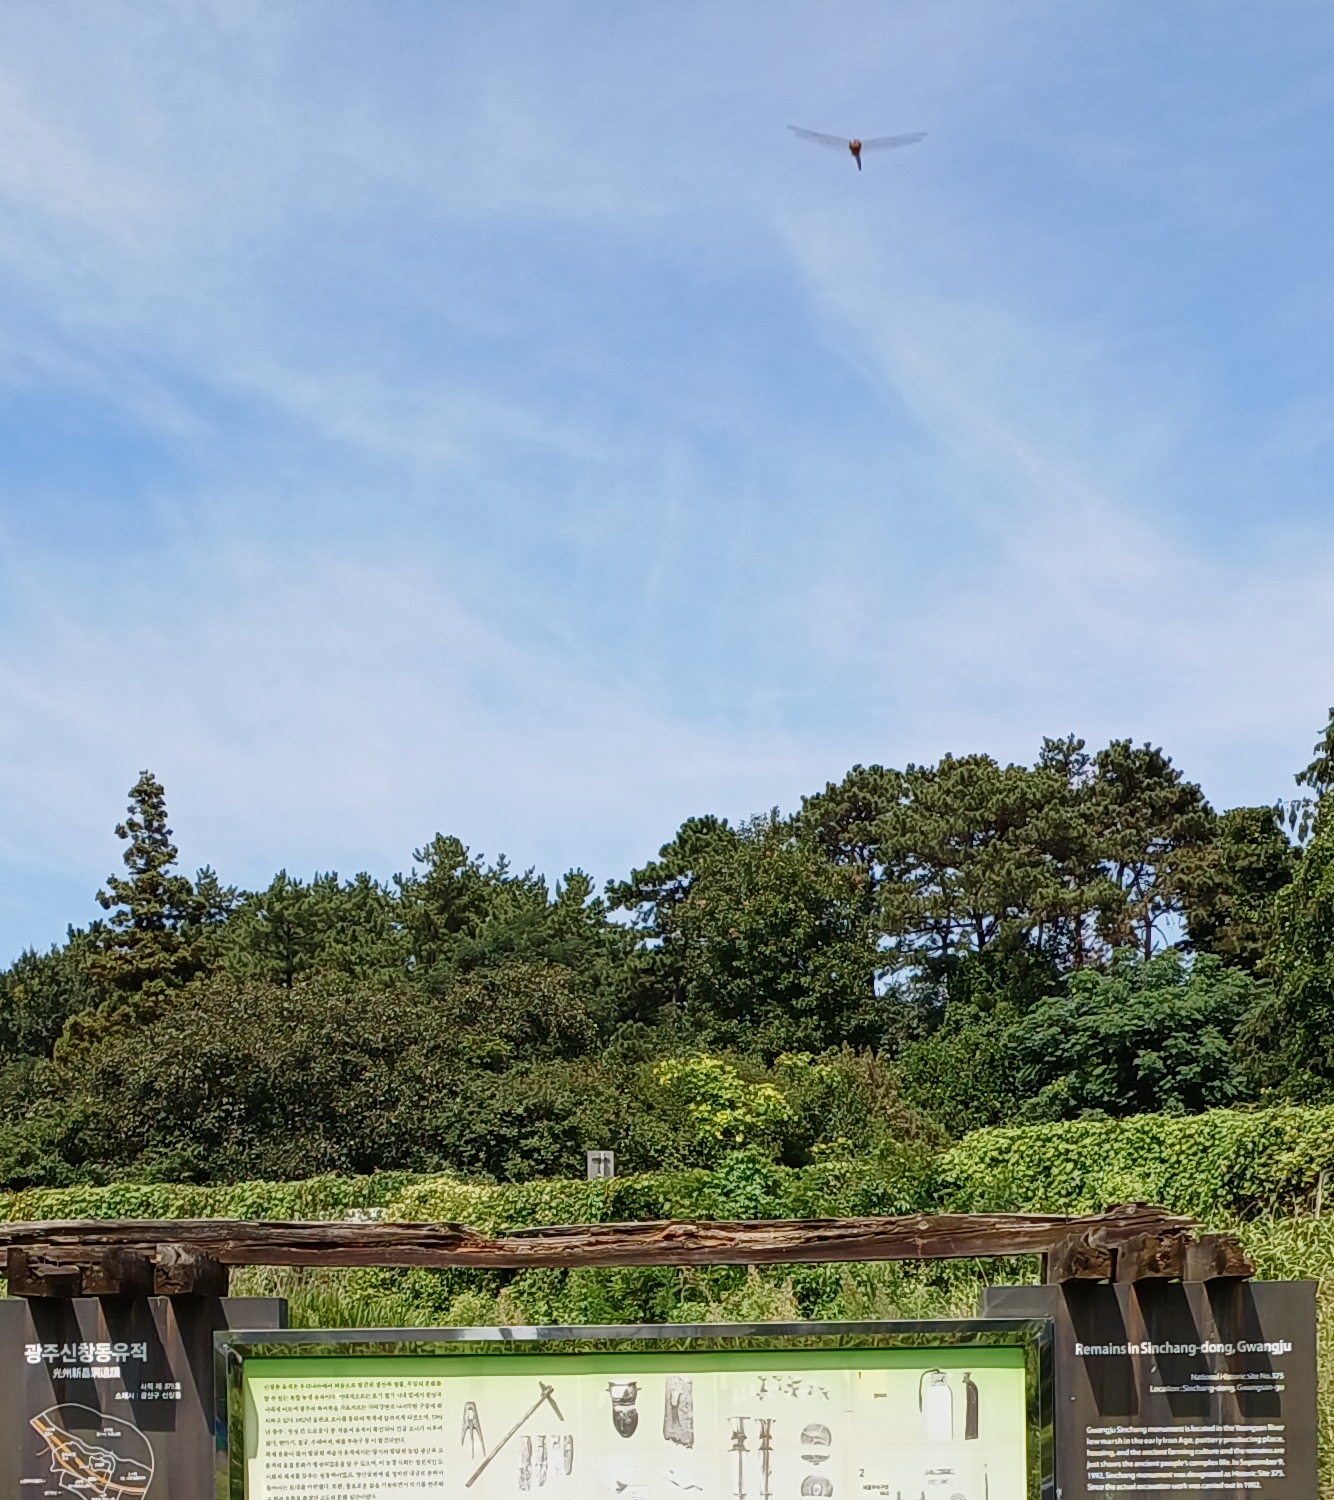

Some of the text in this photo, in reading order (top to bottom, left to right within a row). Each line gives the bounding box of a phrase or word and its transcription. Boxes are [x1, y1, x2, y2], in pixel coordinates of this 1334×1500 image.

[24, 1342, 148, 1363] 광주신창동유적
[1075, 1340, 1292, 1357] Remains in Sinchang-dong, Gwangju
[1191, 1373, 1219, 1381] National
[859, 1469, 865, 1477] 2
